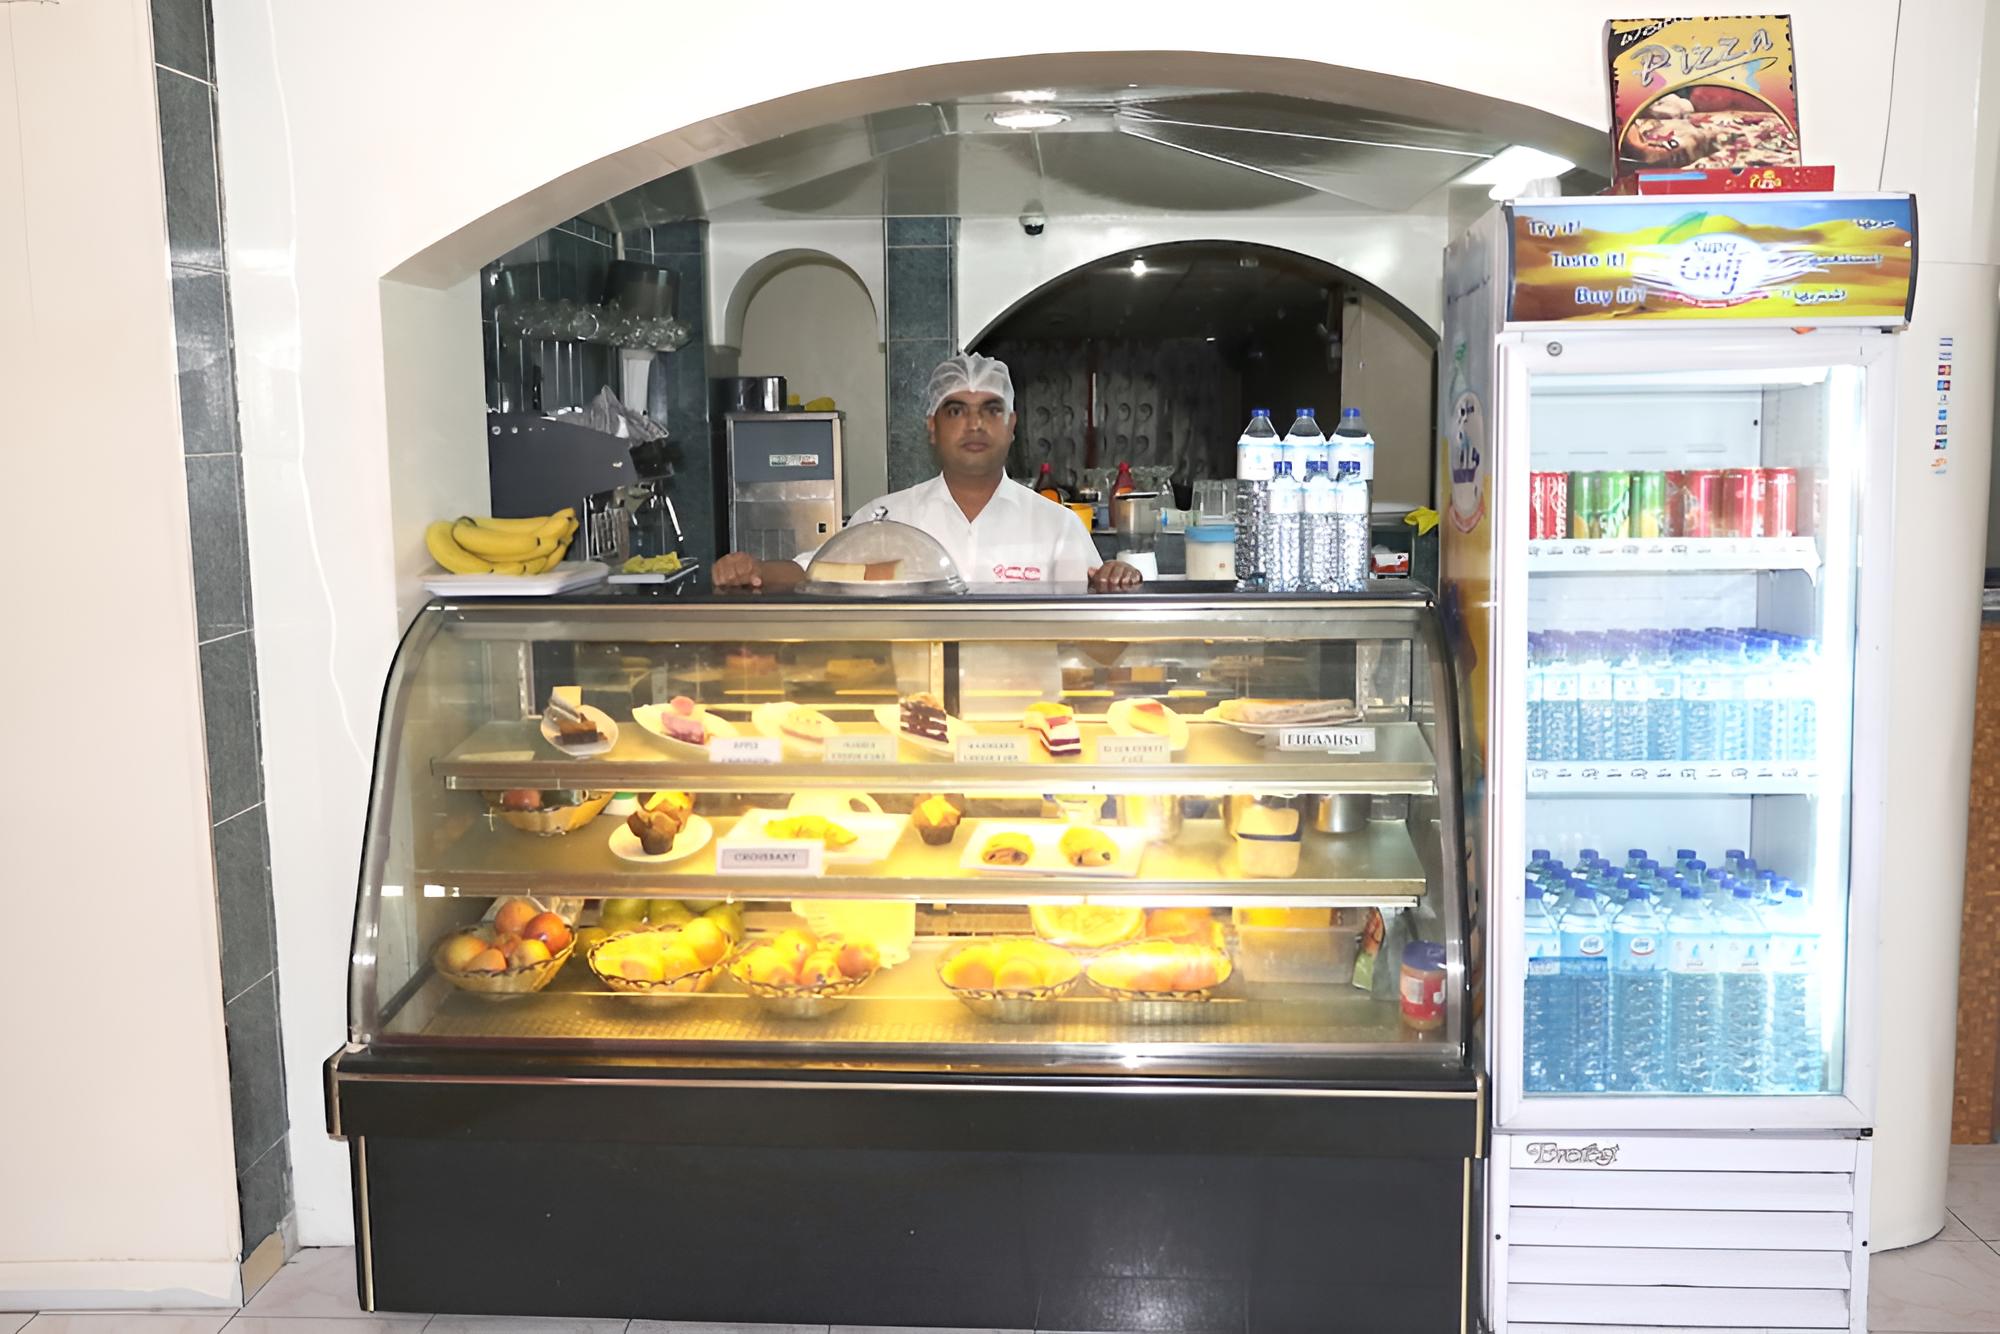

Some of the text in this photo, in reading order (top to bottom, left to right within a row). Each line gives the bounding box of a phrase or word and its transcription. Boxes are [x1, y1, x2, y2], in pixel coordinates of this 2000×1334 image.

[1631, 28, 1774, 88] Pizza
[1529, 220, 1556, 238] Try
[1576, 286, 1613, 304] Buy
